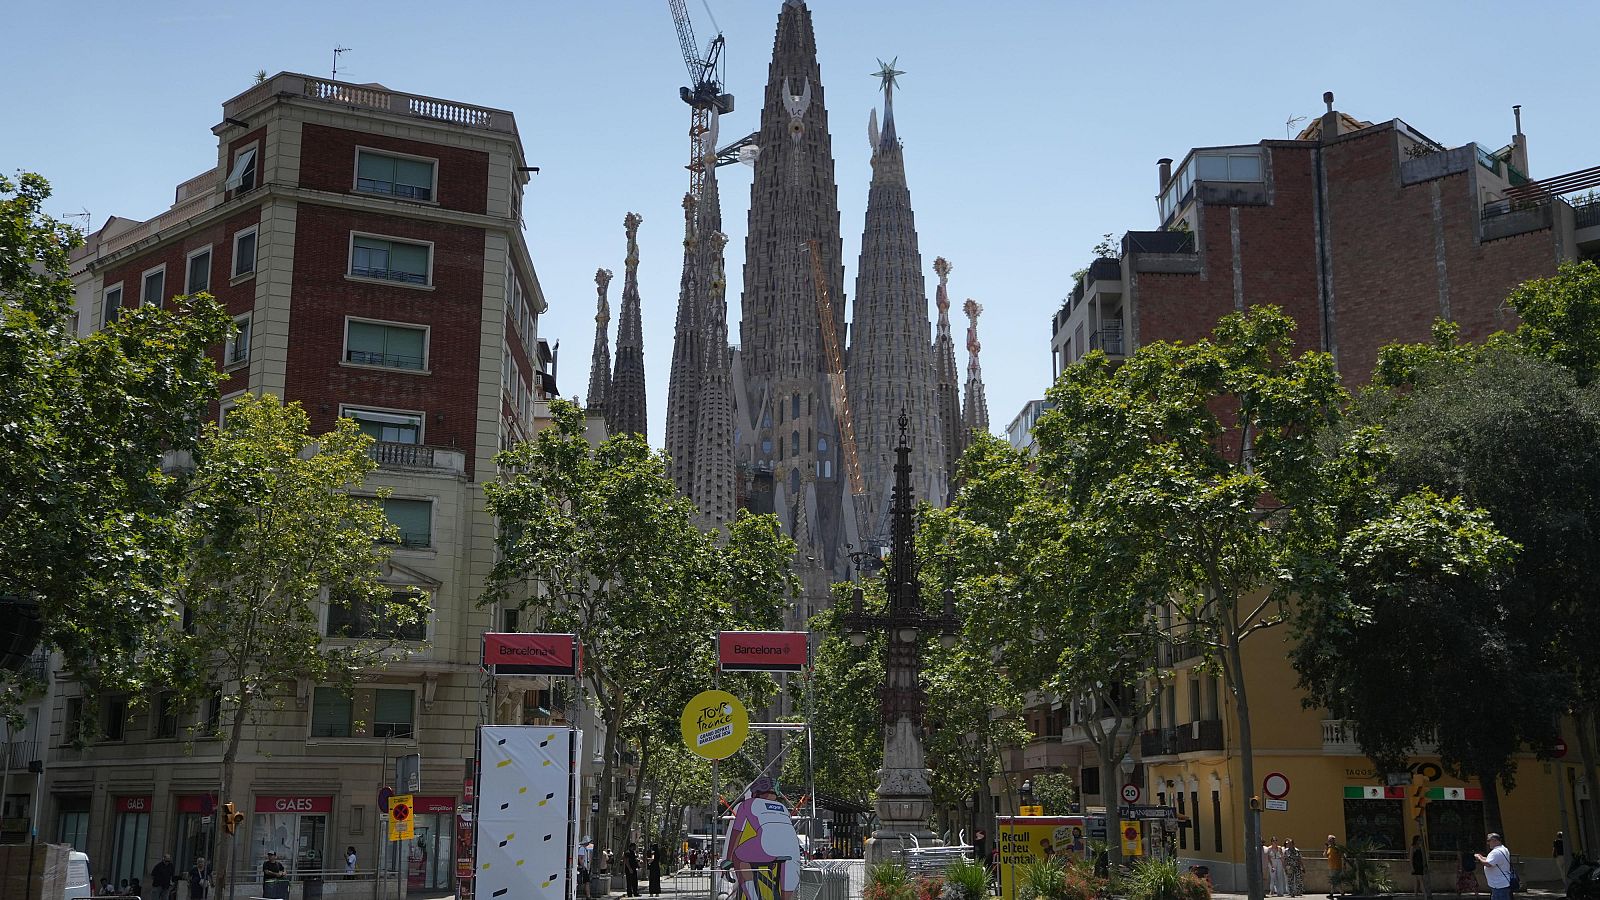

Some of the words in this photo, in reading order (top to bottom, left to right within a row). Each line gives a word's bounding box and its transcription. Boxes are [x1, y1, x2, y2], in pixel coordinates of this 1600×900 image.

[500, 645, 548, 656] Barcelona
[734, 645, 782, 655] Barcelona
[1345, 768, 1372, 776] TACOS
[1125, 789, 1136, 797] 20
[127, 799, 144, 809] GAES
[275, 798, 313, 811] GAES
[1002, 831, 1030, 842] Recull
[1002, 843, 1011, 853] el
[1012, 843, 1028, 853] teu
